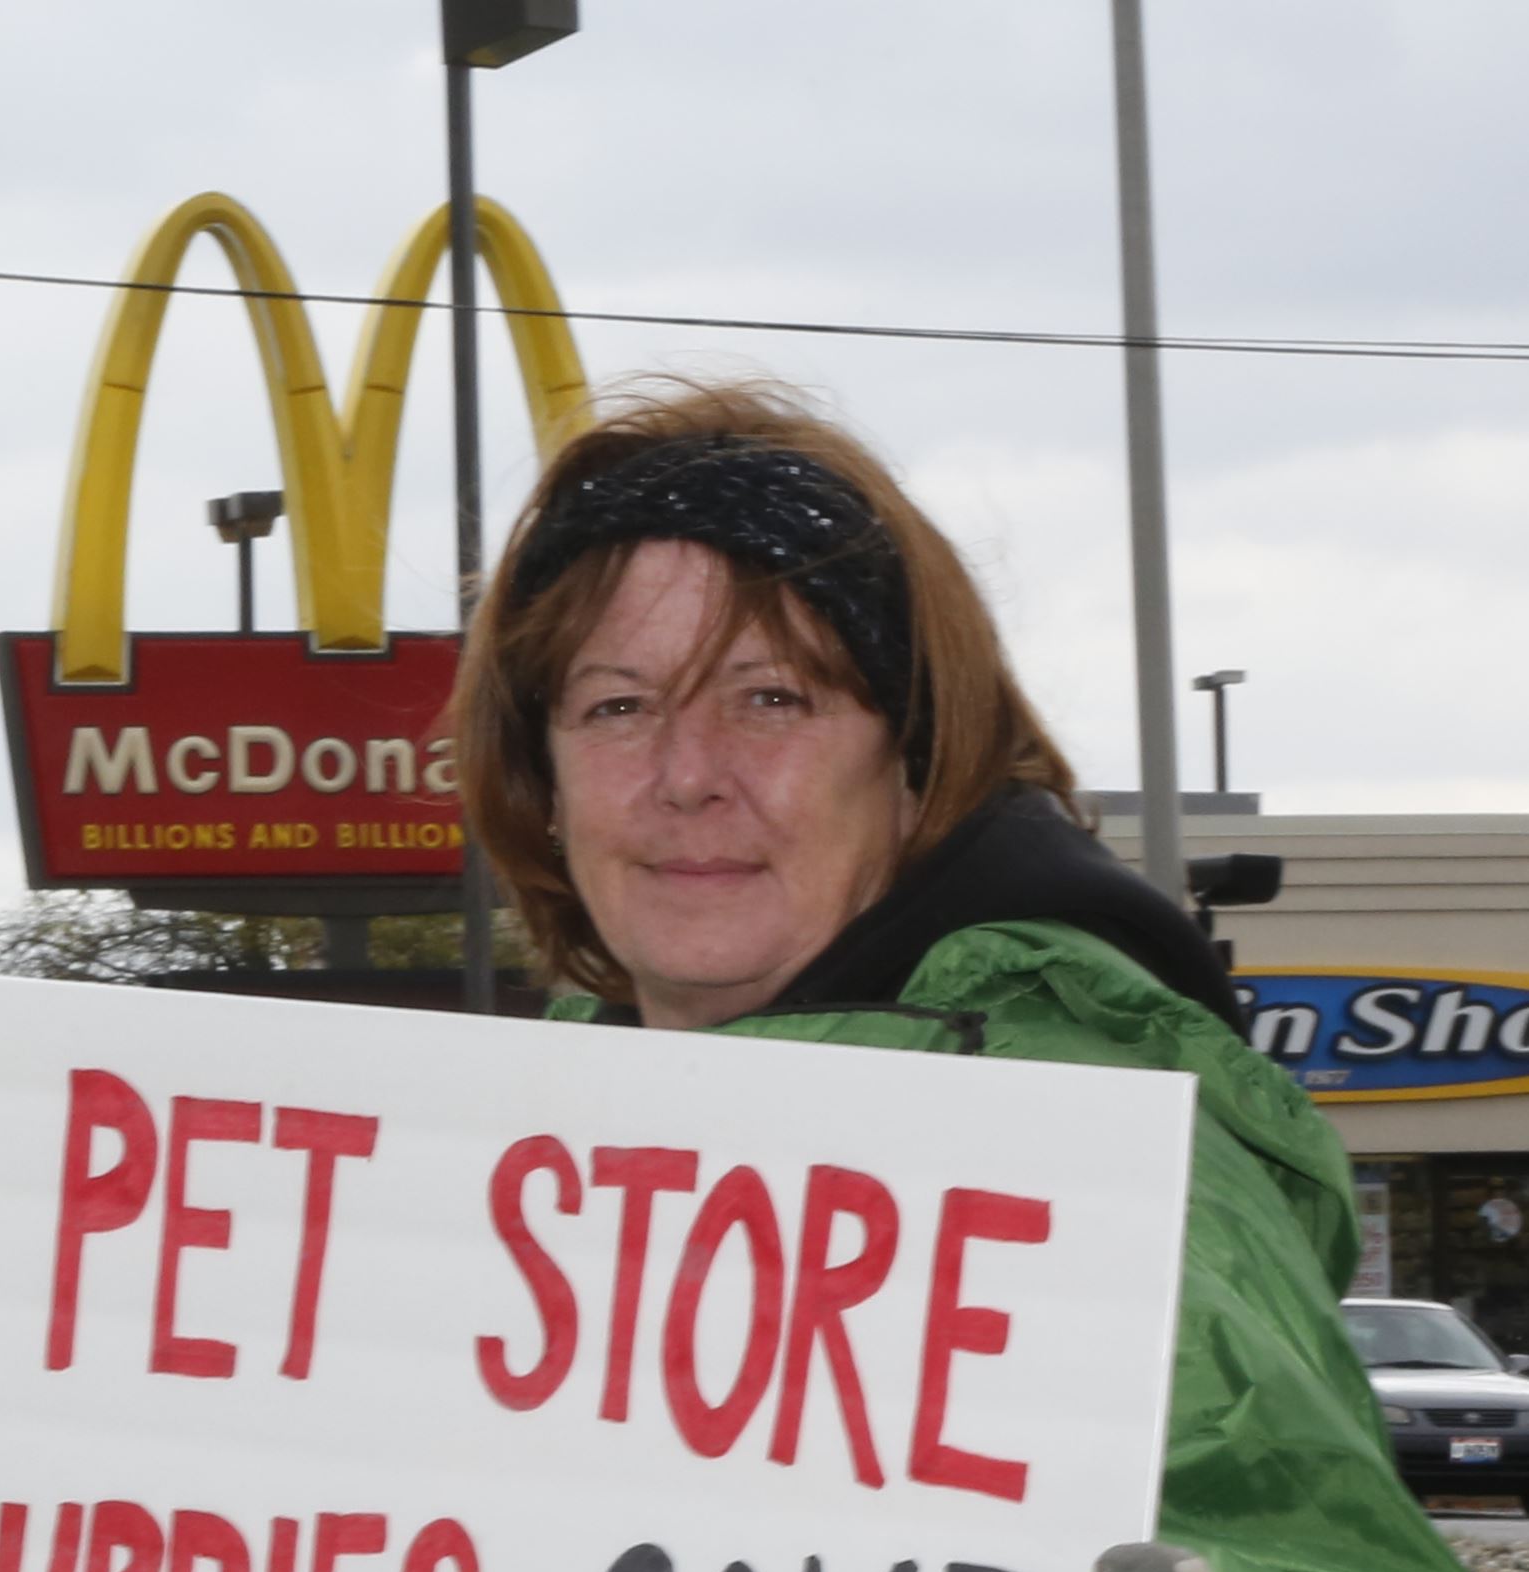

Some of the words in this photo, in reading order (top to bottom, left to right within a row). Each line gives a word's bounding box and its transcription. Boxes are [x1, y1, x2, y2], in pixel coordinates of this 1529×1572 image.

[83, 822, 236, 850] BILLIONS
[250, 822, 318, 849] AND
[46, 1067, 380, 1381] PET
[474, 1133, 1051, 1502] STORE
